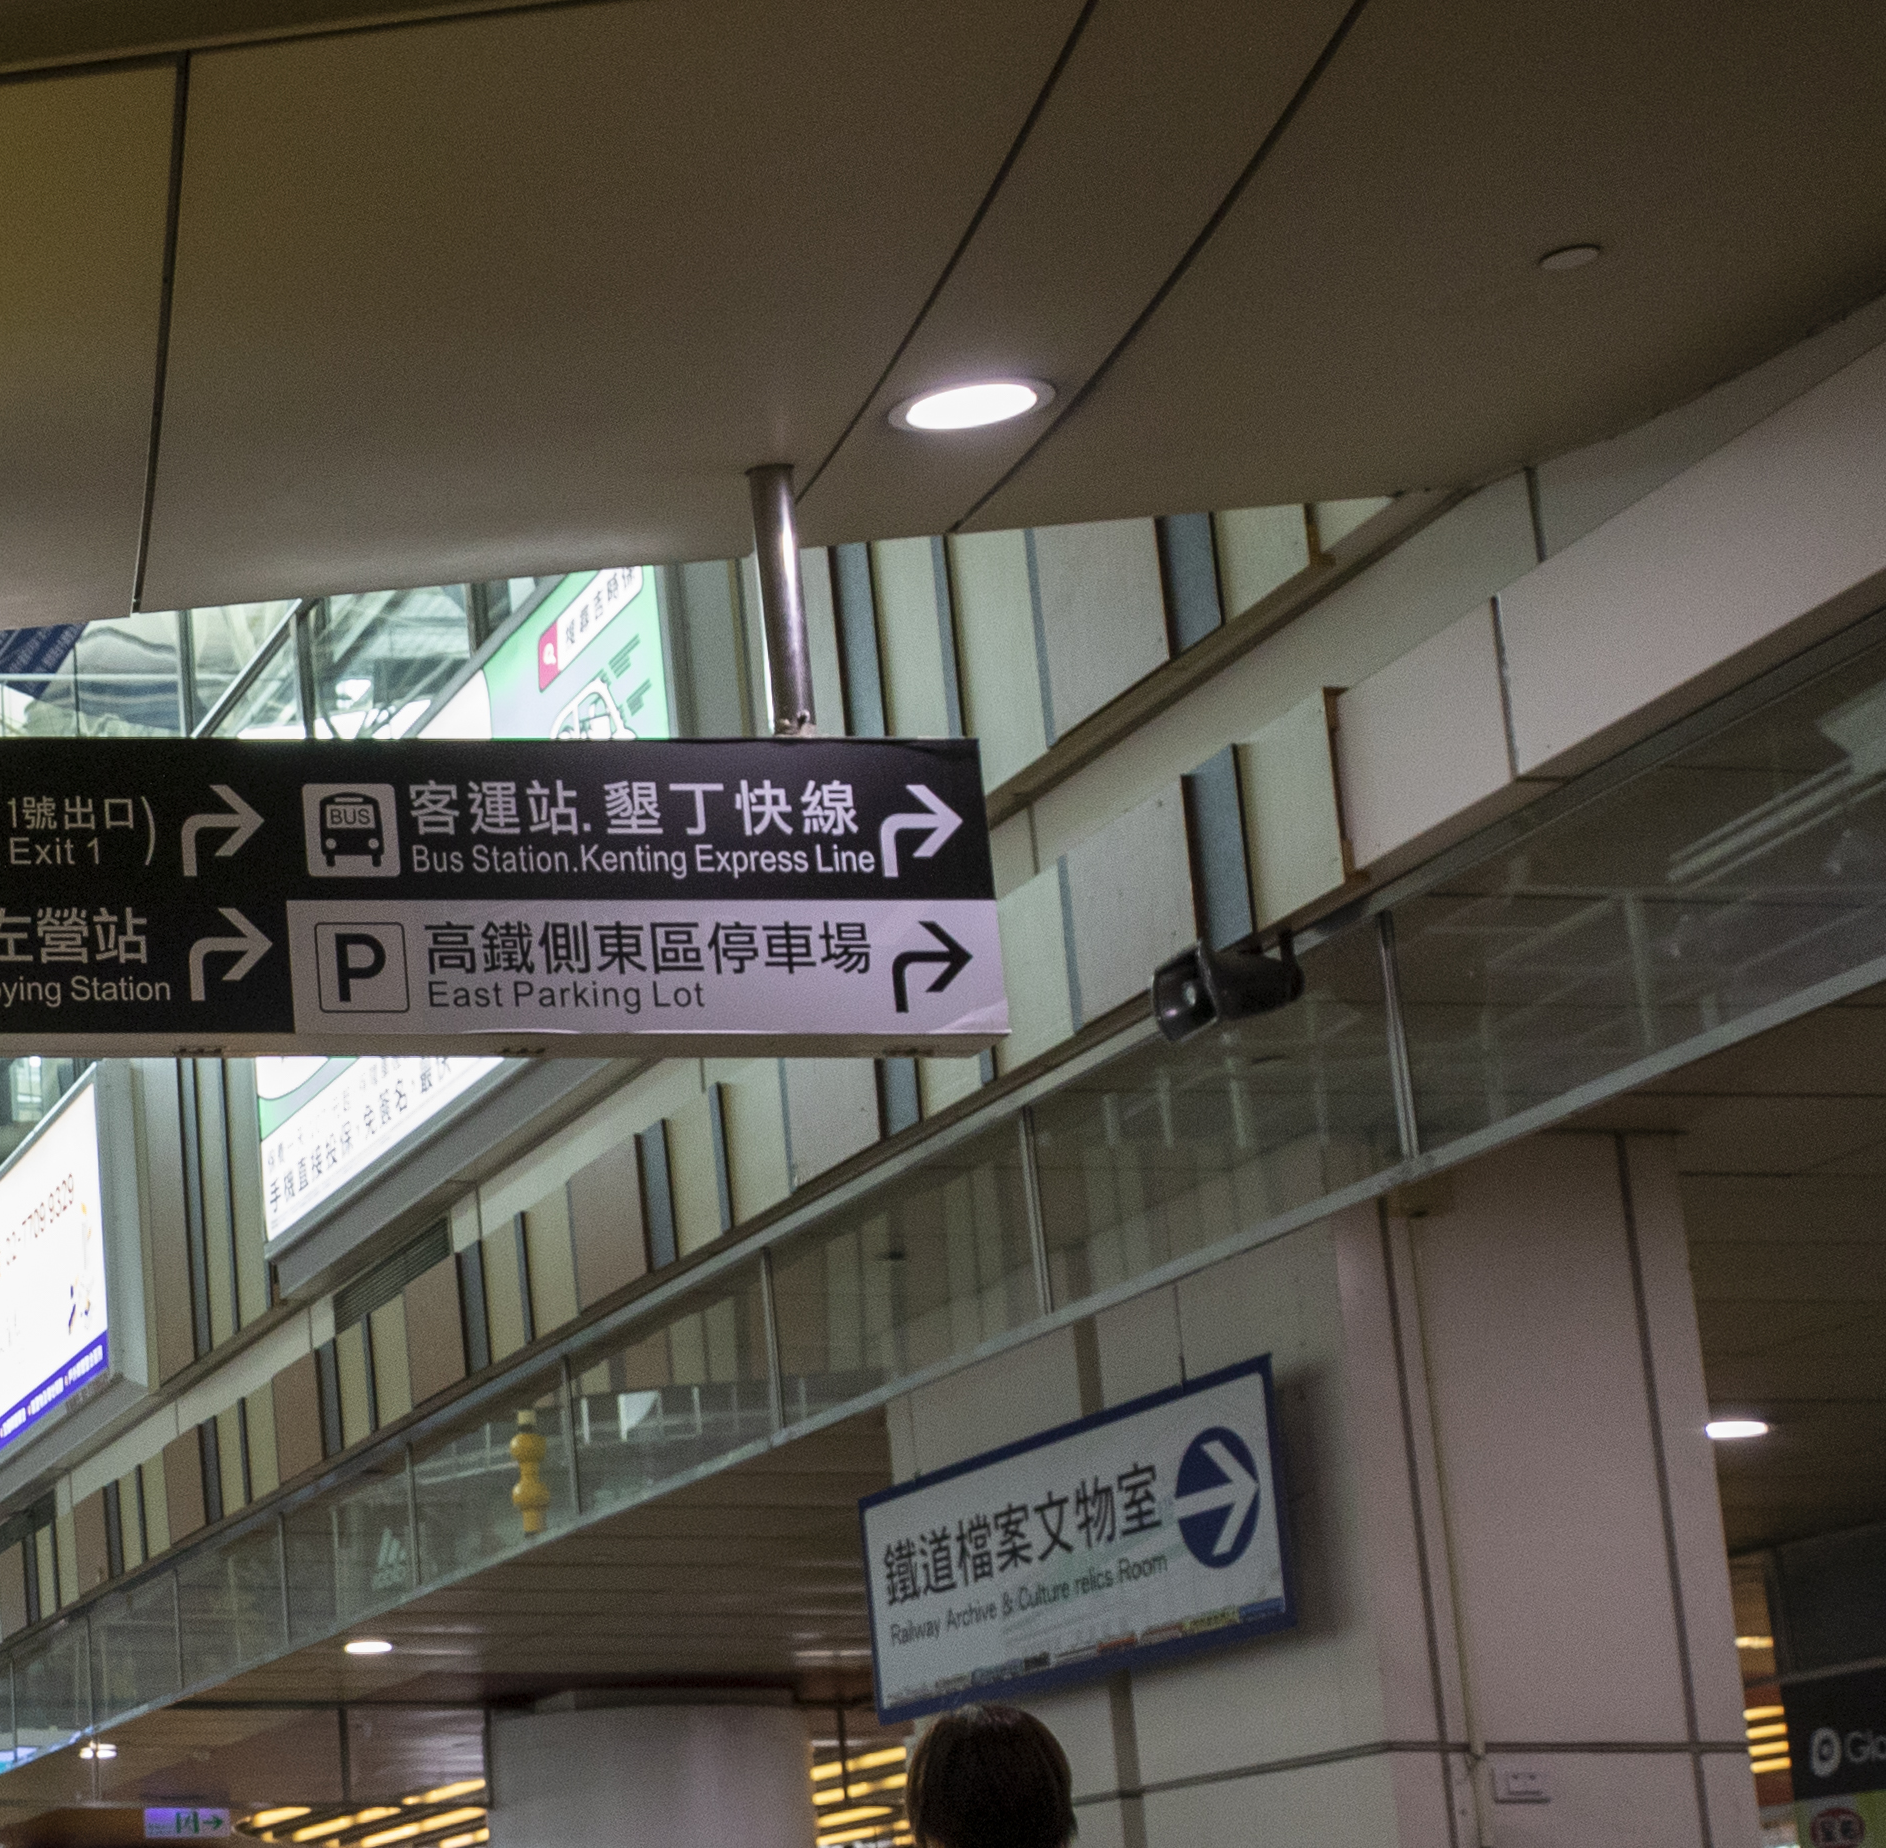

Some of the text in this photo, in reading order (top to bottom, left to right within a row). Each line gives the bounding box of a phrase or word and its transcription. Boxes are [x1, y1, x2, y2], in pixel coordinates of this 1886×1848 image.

[329, 807, 371, 827] BUS
[9, 837, 101, 866] Exit 1
[412, 844, 465, 874] Bus
[695, 844, 810, 879] Express
[815, 844, 877, 874] Line
[424, 920, 873, 976] 高鐵側東區停車場
[70, 975, 171, 1002] Station
[428, 981, 706, 1014] East Parking Lot
[883, 1462, 1163, 1606] 鐵道檔案文物室
[889, 1550, 1170, 1647] Railway Archive & Culture relics Room
